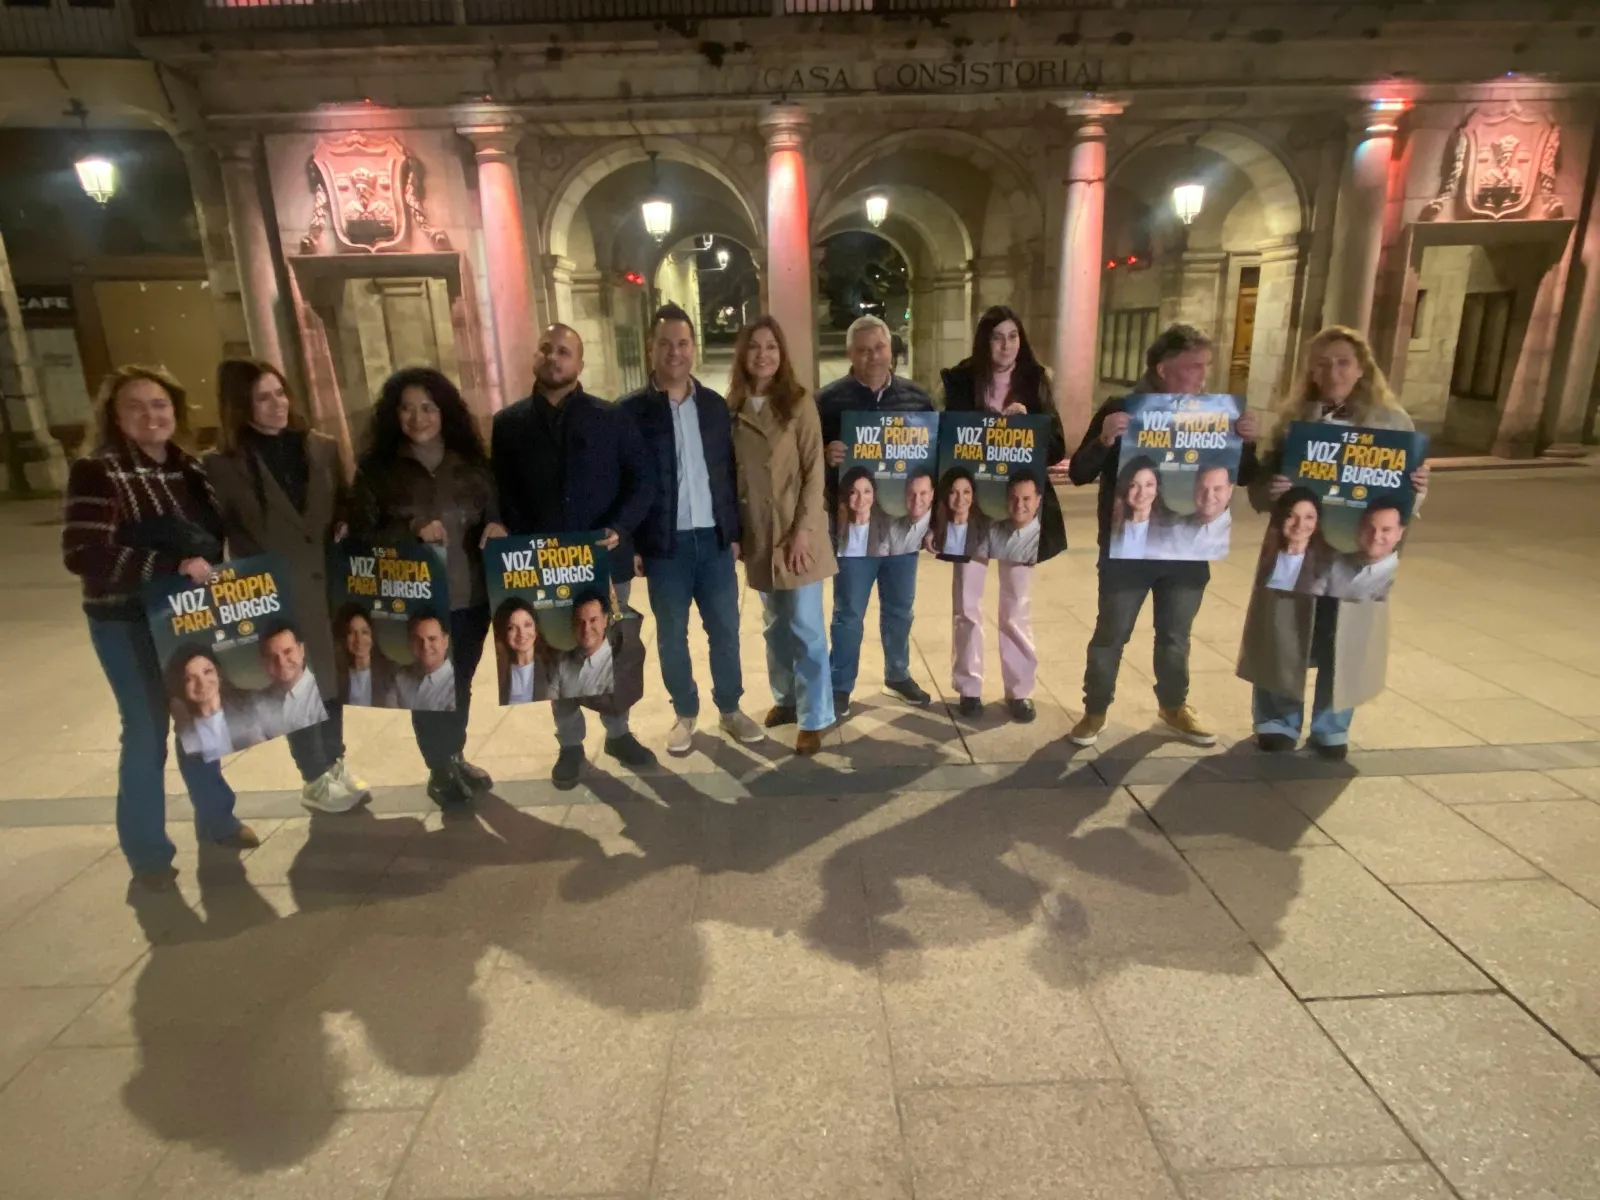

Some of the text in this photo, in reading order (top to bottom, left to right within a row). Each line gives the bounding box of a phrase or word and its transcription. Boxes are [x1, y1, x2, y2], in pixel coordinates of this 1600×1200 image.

[764, 59, 1106, 90] CASA CONSISTORIAL
[1142, 411, 1229, 432] VOZ PROPIA
[856, 427, 929, 445] VOZ PROPIA
[957, 427, 1034, 448] VOZ PROPIA
[1137, 431, 1227, 449] PARA BURGOS
[854, 443, 929, 459] PARA BURGOS
[954, 444, 1033, 463] PARA BURGOS
[1307, 440, 1406, 471] VOZ PROPIA
[1299, 461, 1403, 488] PARA BURGOS
[350, 556, 431, 582] VOZ PROPIA
[501, 545, 594, 572] VOZ PROPIA
[347, 575, 432, 599] PARA BURGOS
[503, 564, 595, 589] PARA BURGOS
[168, 572, 278, 616] VOZ PROPIA
[172, 593, 280, 636] PARA BURGOS
